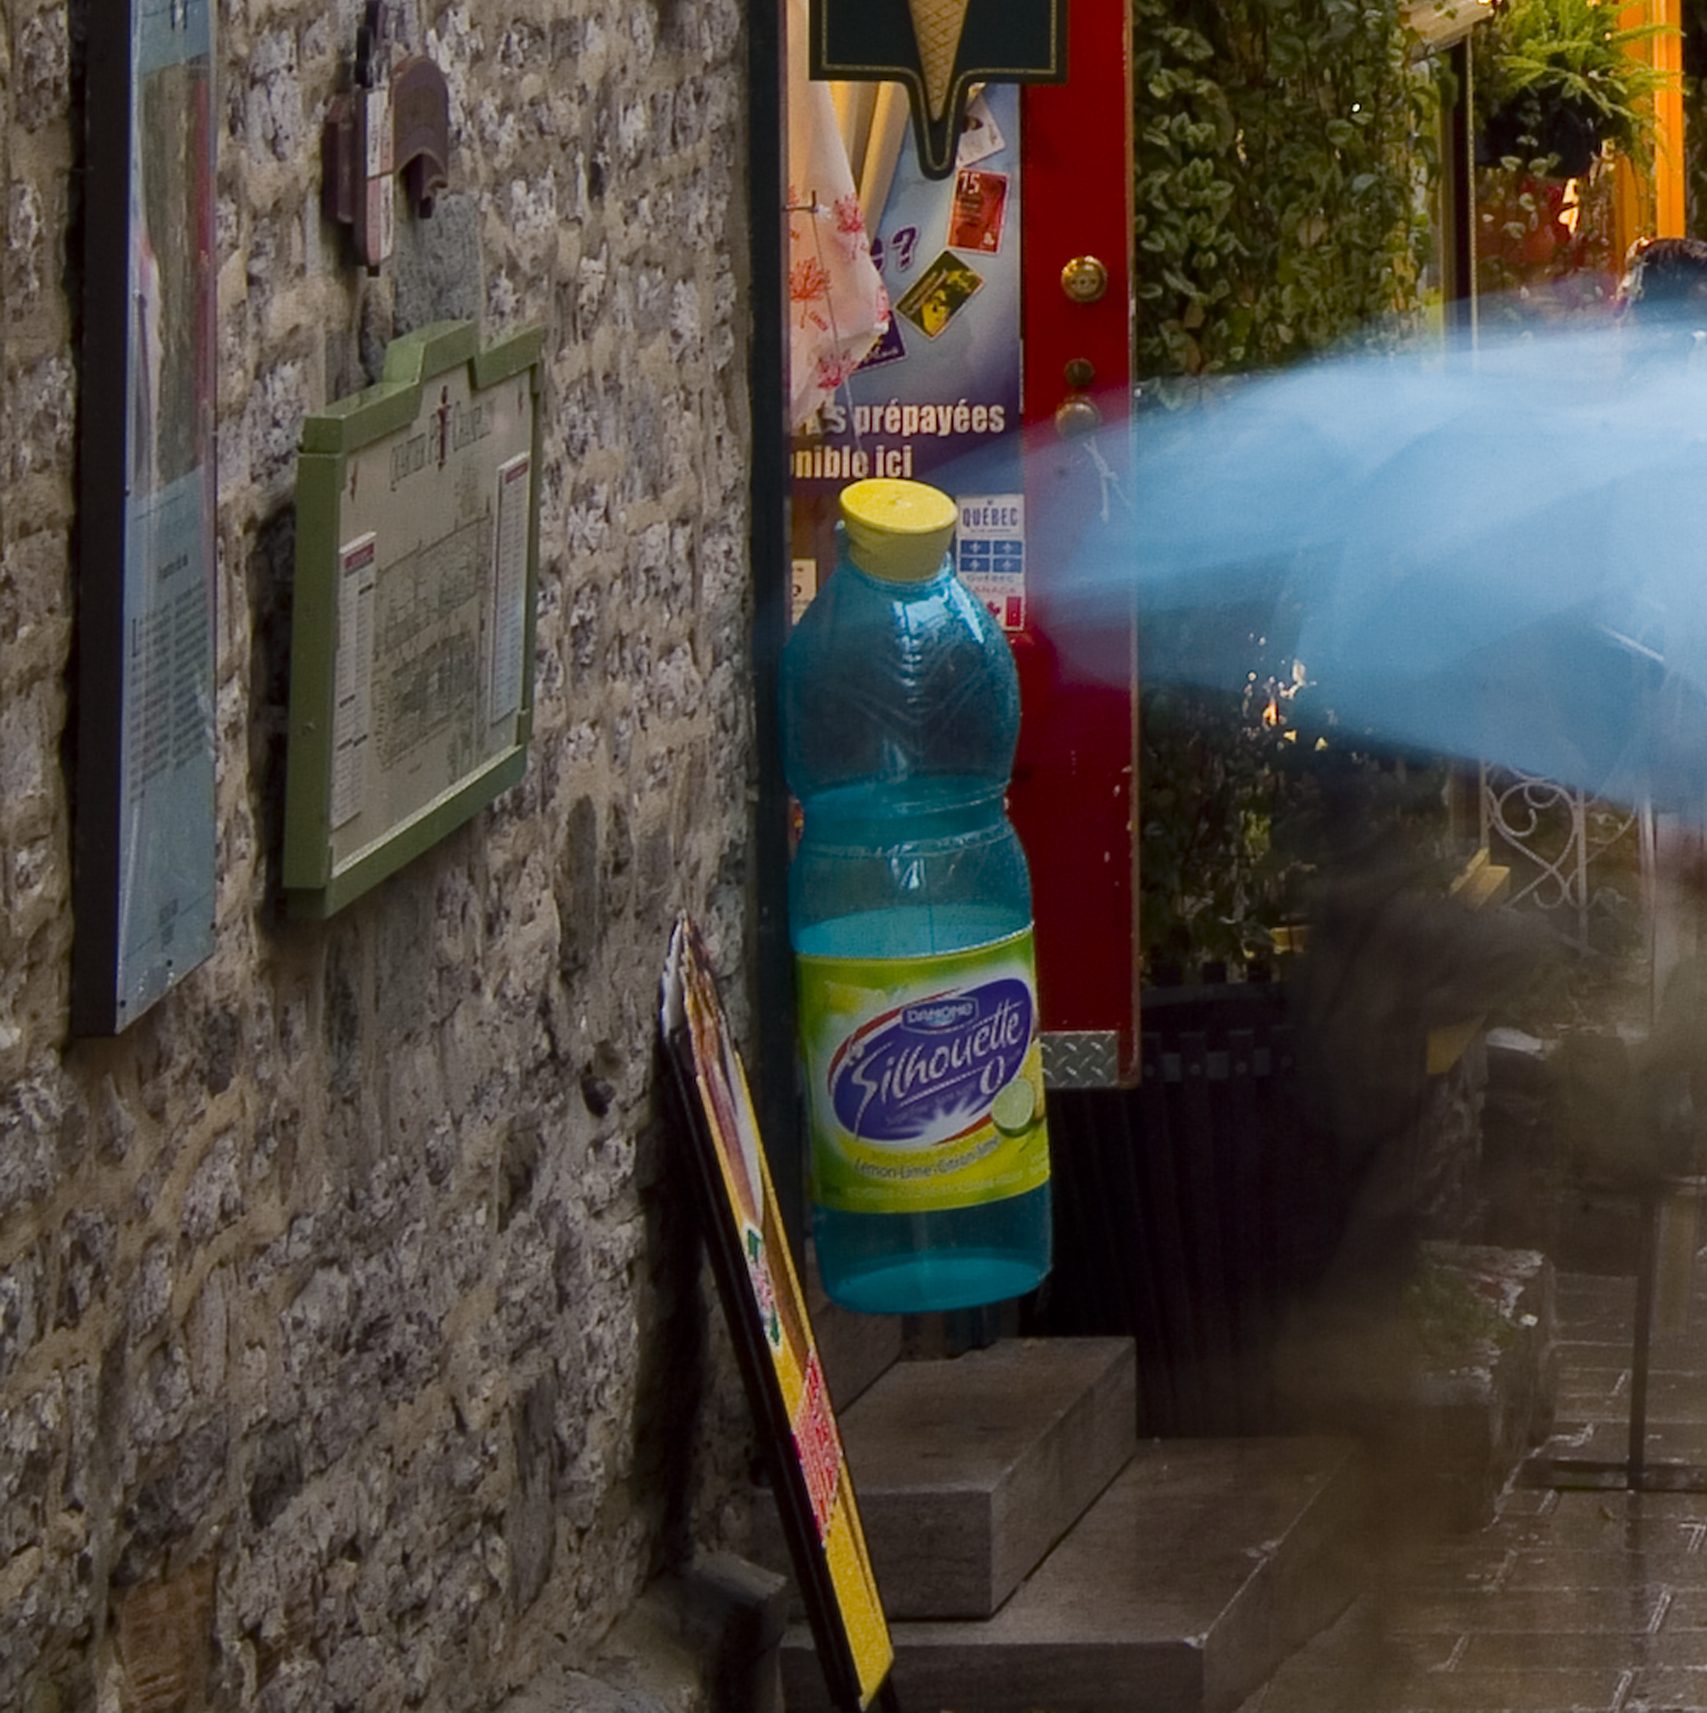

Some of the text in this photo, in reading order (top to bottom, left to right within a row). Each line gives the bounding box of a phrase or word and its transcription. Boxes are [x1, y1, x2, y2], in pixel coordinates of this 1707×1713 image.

[854, 396, 1006, 437] prépayées
[790, 443, 914, 479] nible ici
[850, 998, 1025, 1142] Silhouette
